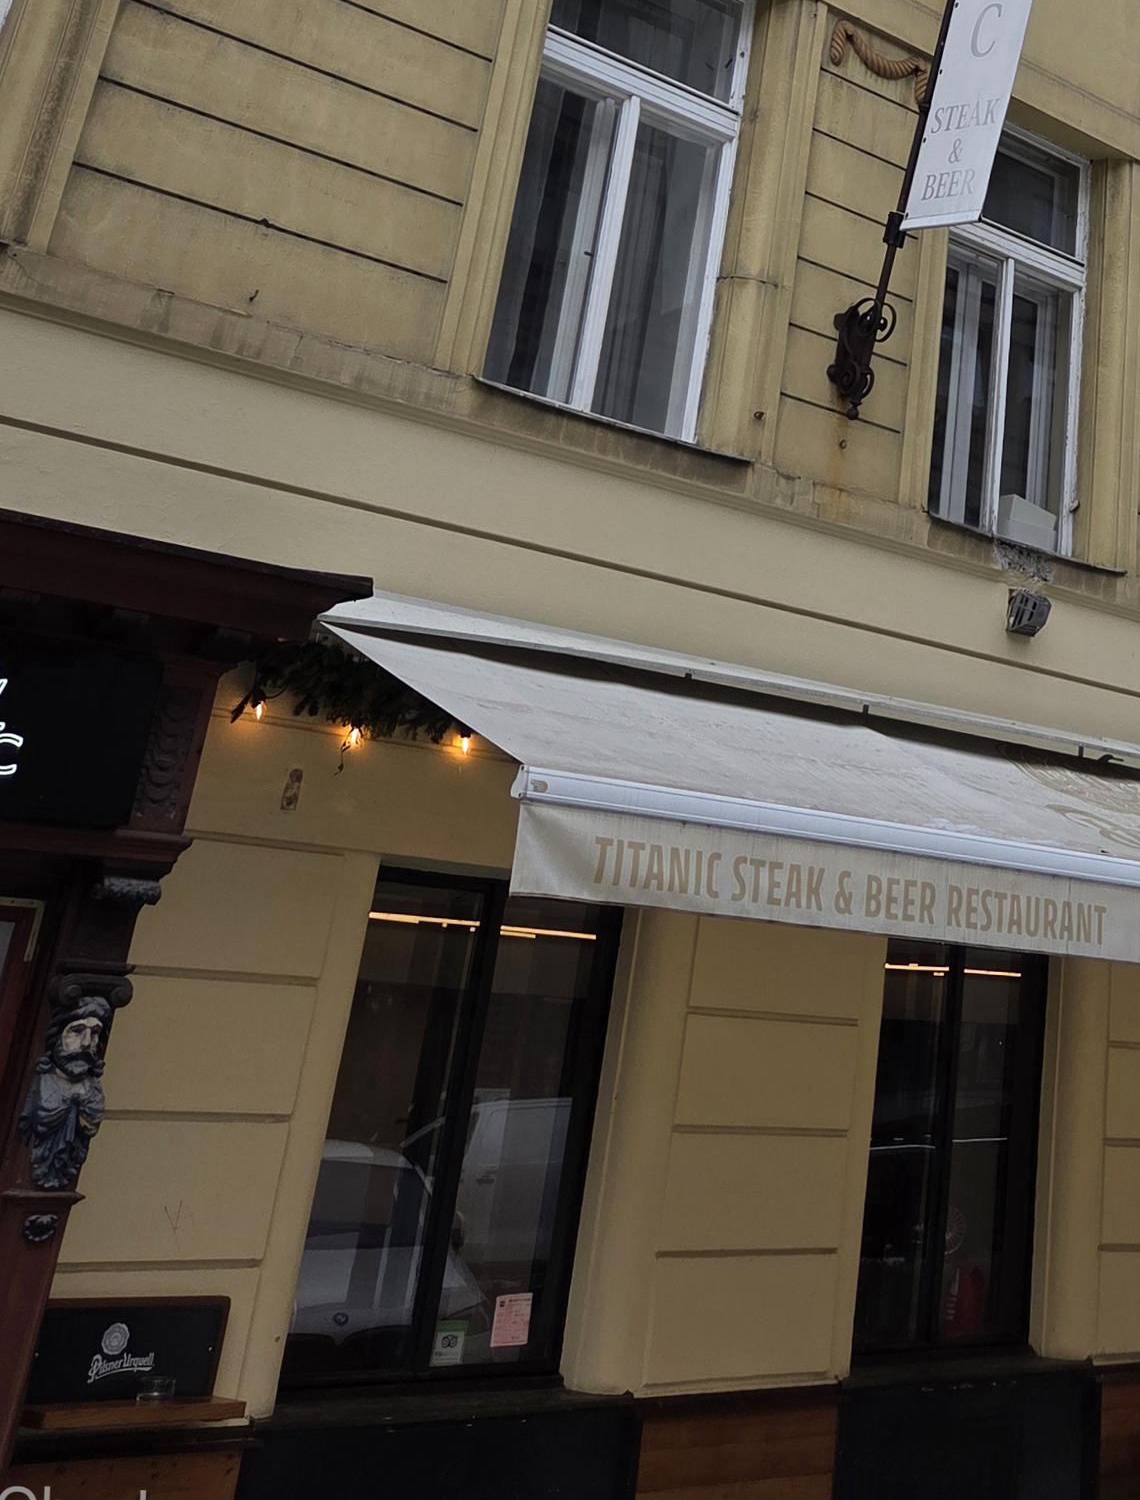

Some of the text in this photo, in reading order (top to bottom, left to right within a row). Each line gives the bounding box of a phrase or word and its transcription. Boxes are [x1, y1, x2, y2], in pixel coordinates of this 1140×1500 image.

[930, 97, 999, 136] STEAK
[948, 137, 964, 165] &
[921, 167, 976, 202] BEER
[593, 835, 1108, 946] TITANIC STEAK & BEER RESTAURANT
[87, 1352, 155, 1383] Pilsner Urquell
